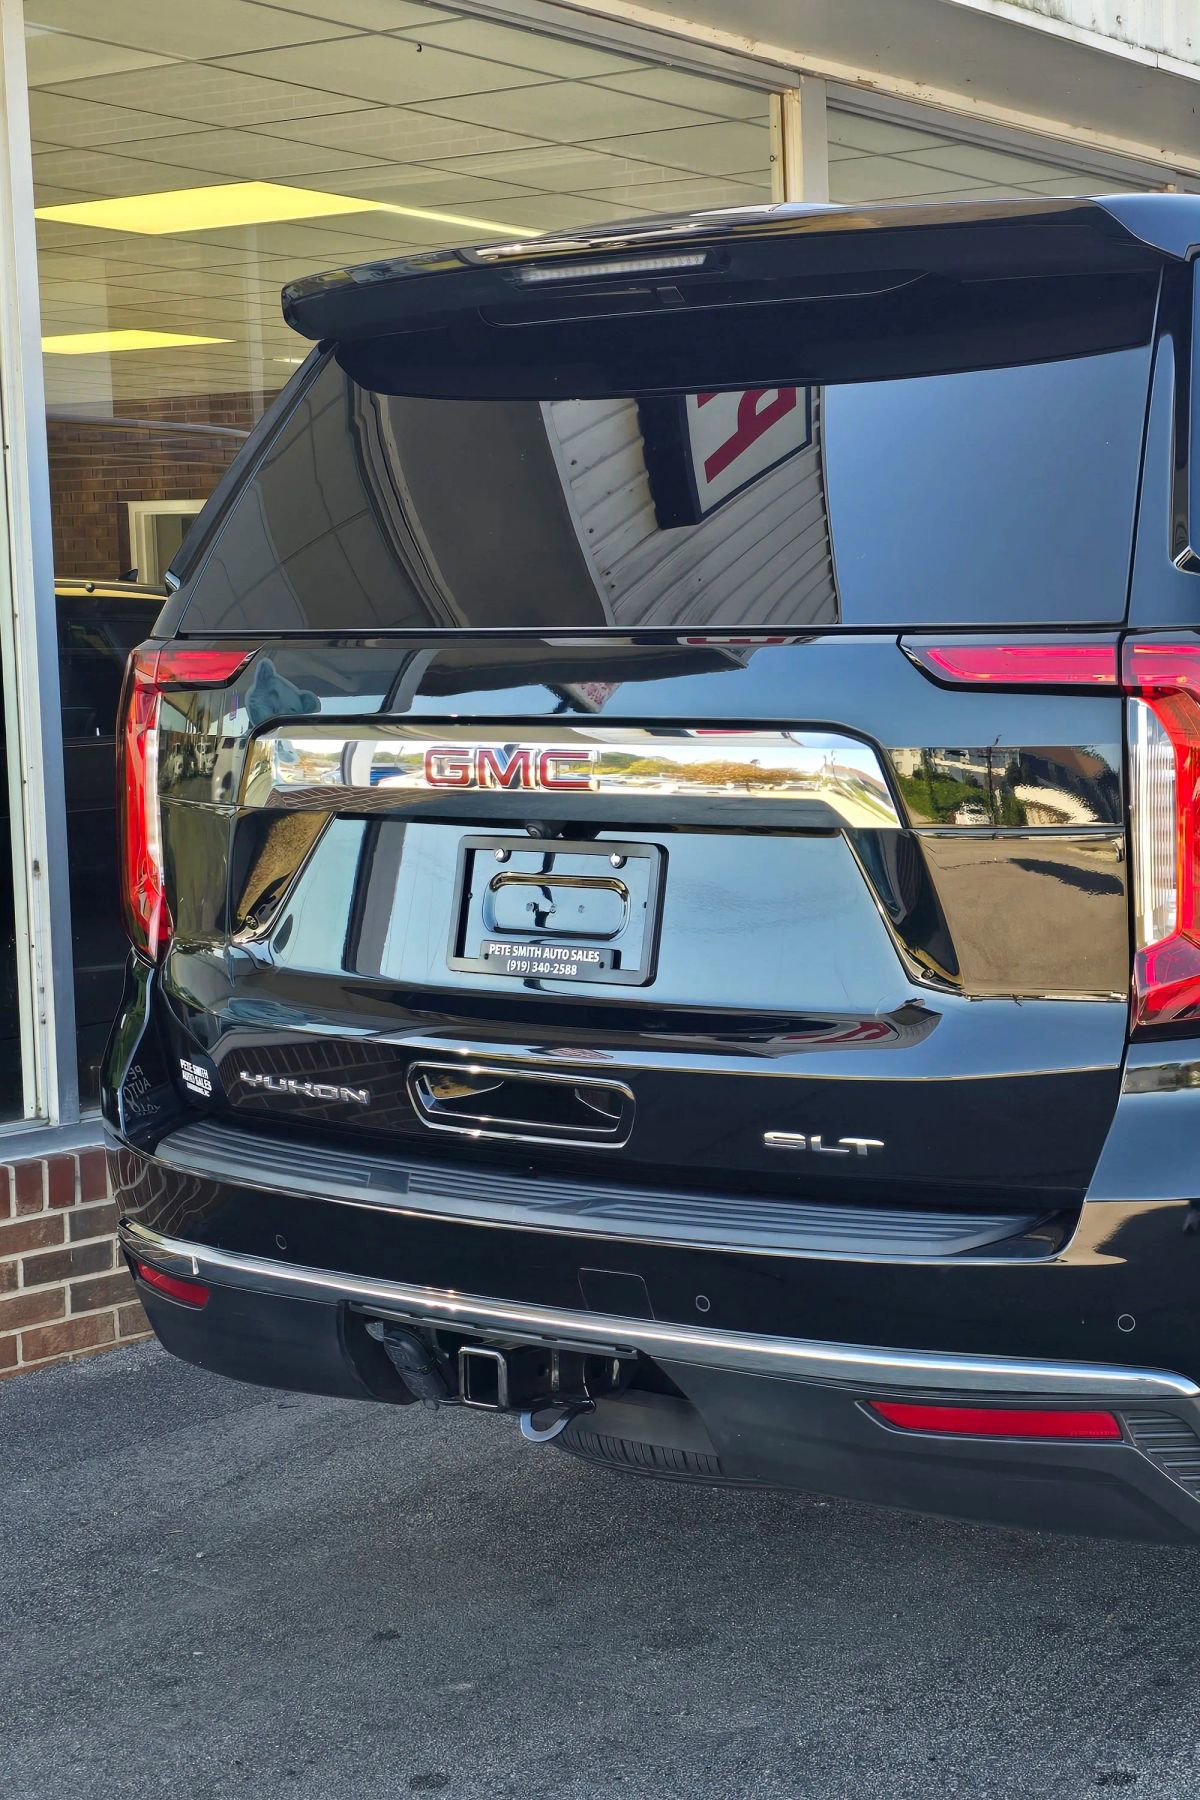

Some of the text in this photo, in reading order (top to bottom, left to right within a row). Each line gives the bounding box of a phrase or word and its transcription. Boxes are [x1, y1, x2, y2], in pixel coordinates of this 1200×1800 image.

[424, 743, 600, 792] GMC
[489, 943, 600, 963] PETE SMITH AUTO SALES
[506, 959, 578, 976] (919) 340-2588
[239, 1070, 371, 1105] YUKON
[763, 1131, 885, 1157] SLT
